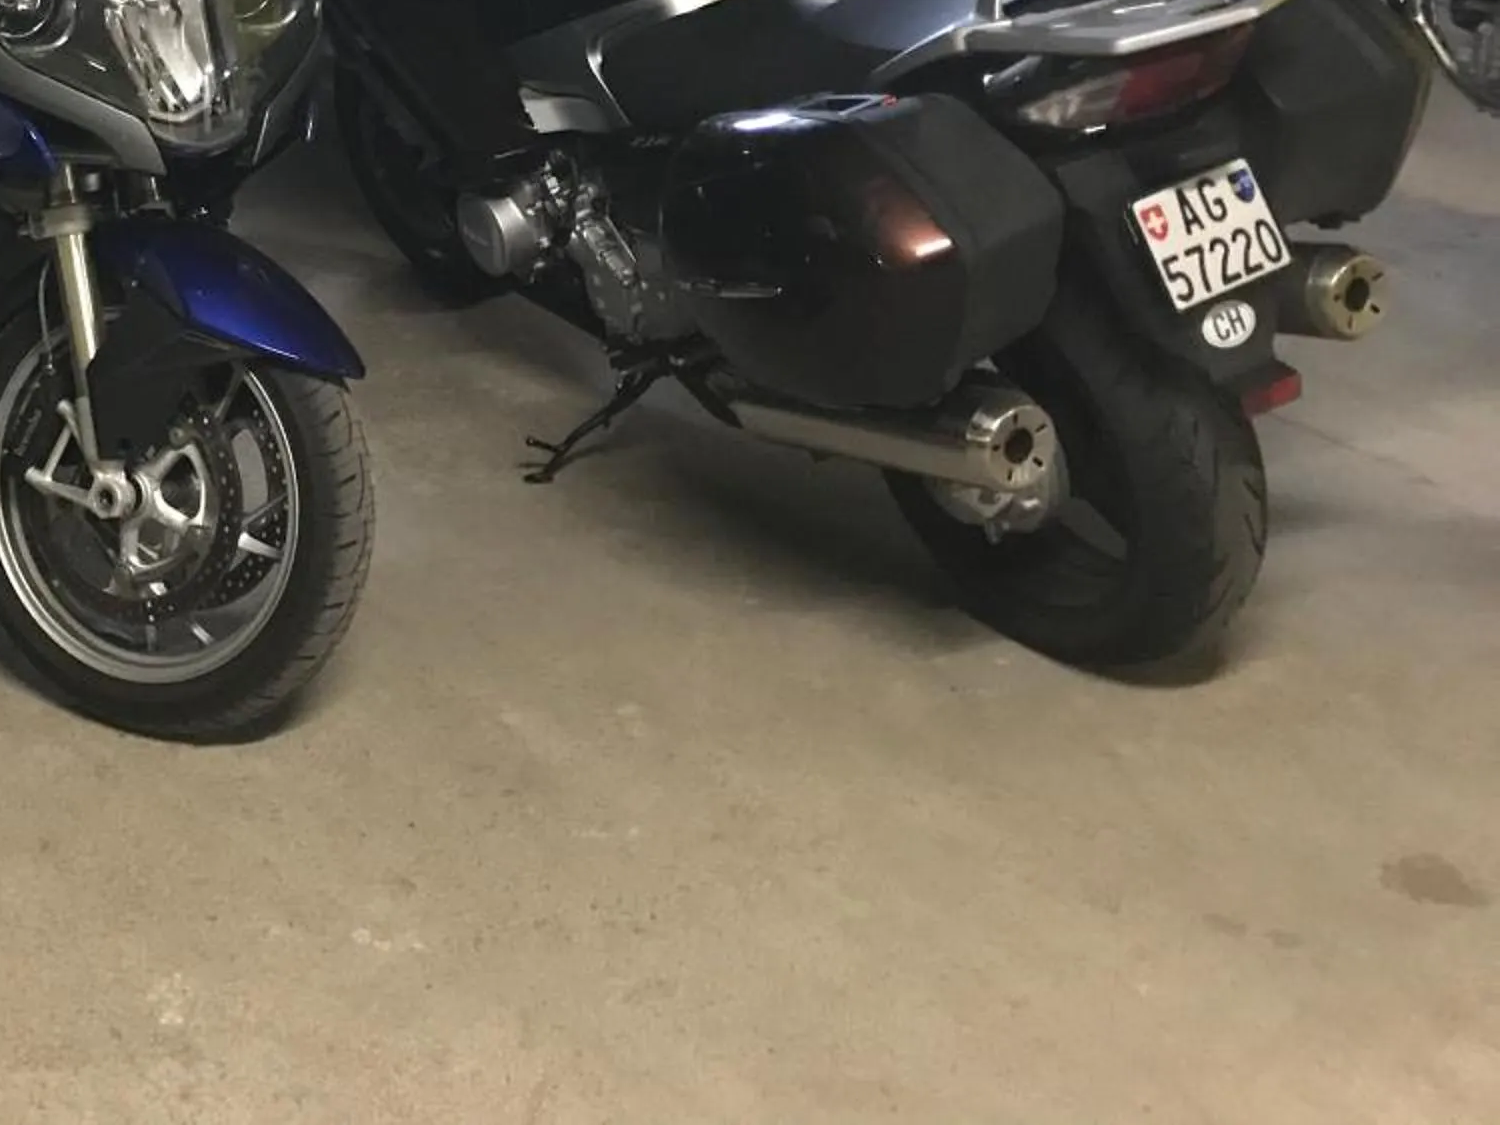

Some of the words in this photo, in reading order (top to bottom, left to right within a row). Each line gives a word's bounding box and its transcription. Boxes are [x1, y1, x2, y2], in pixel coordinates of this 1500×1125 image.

[1175, 177, 1228, 236] AG
[1161, 218, 1283, 303] 57220
[1212, 306, 1247, 342] CH
